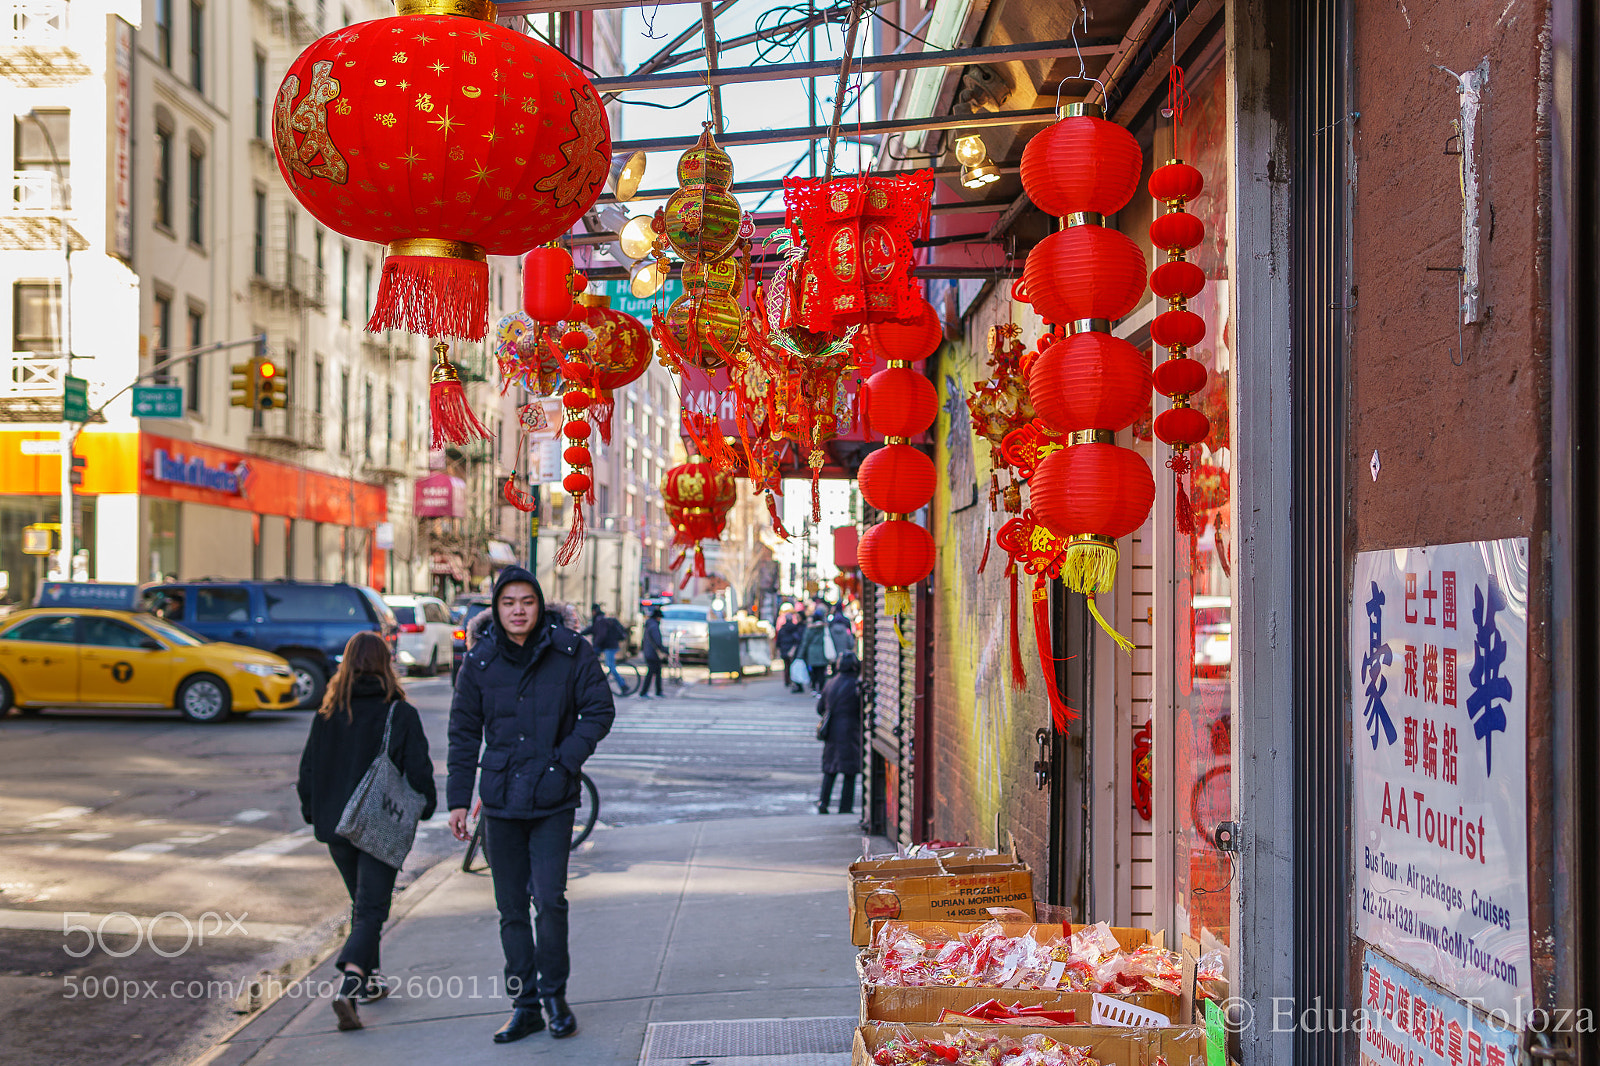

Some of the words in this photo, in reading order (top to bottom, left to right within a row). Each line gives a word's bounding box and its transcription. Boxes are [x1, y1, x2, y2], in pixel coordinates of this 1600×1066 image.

[392, 51, 408, 64] 福
[335, 98, 351, 116] 福
[415, 93, 435, 113] 福
[521, 97, 539, 115] 福
[620, 295, 670, 312] Tunnel
[1029, 524, 1056, 553] 餘
[69, 586, 127, 599] CAPSULE
[1404, 570, 1457, 631] 巴士團
[1361, 580, 1398, 751] 豪
[1466, 573, 1512, 778] 華
[1404, 643, 1457, 709] 飛機團
[1403, 715, 1458, 786] 郵輪船
[1413, 791, 1485, 864] Tourist
[960, 886, 1000, 896] FROZEN
[1365, 846, 1379, 873] Bus
[1407, 863, 1419, 890] Air
[1471, 889, 1510, 931] Cruises
[931, 899, 965, 908] DURIAN
[968, 893, 1027, 905] MORNTHONG
[946, 909, 956, 918] 14
[958, 908, 977, 916] KGS
